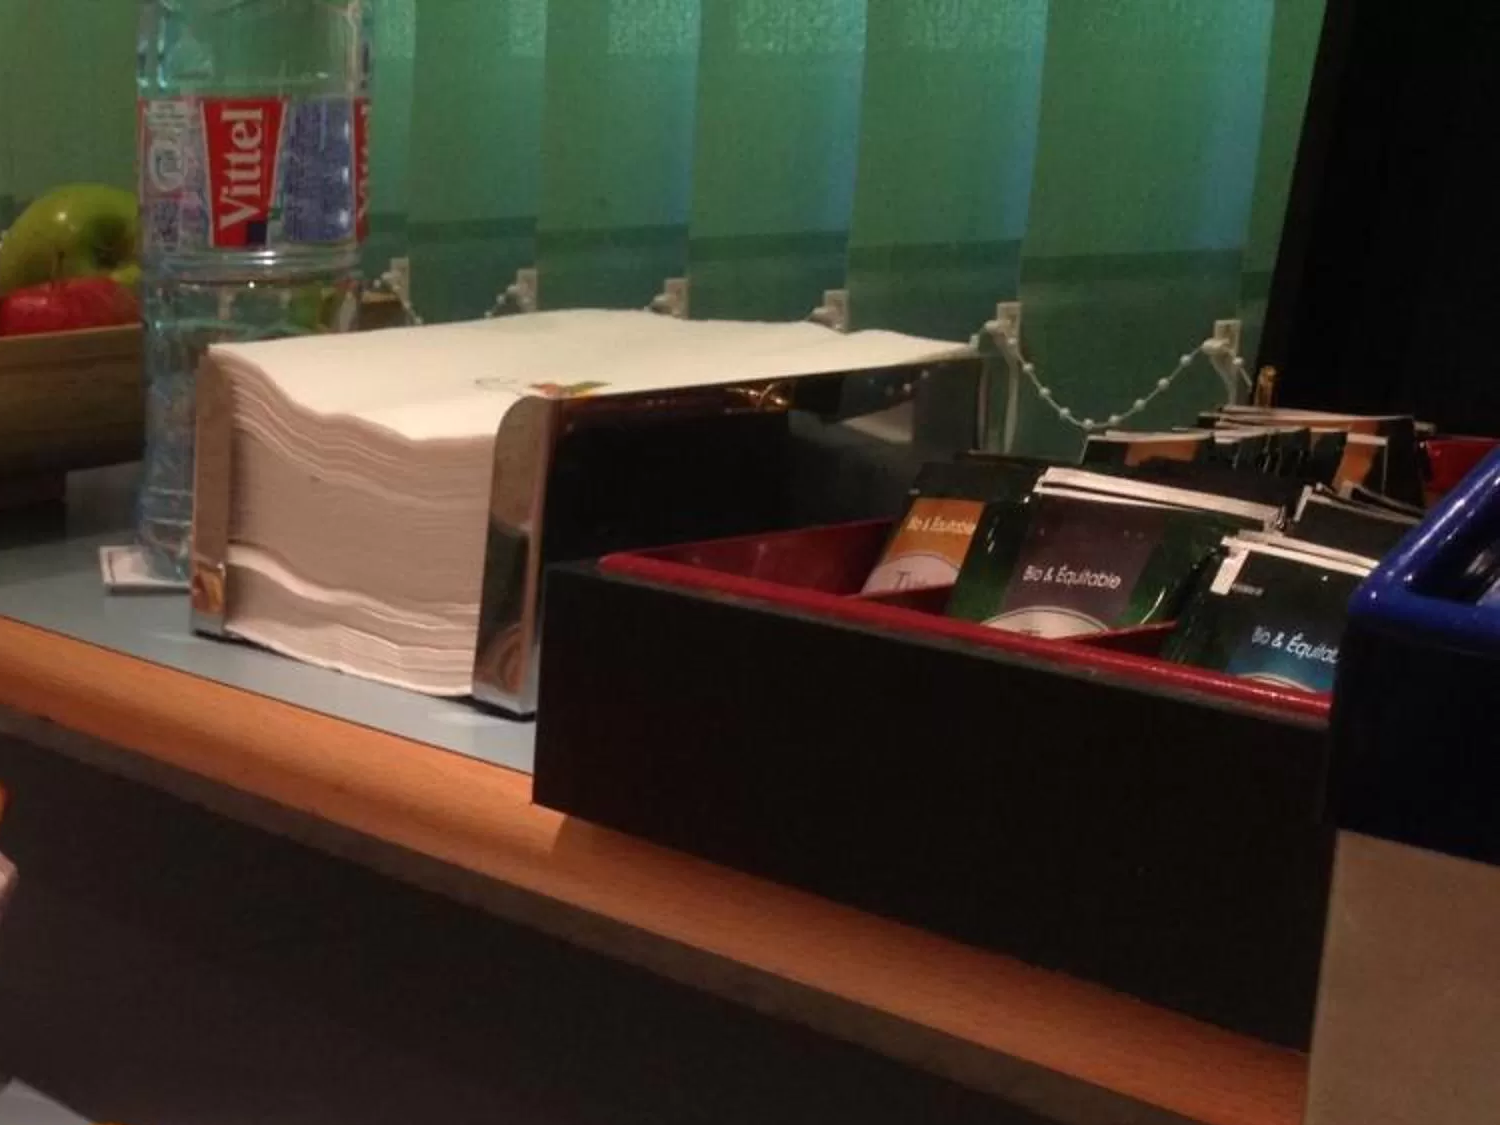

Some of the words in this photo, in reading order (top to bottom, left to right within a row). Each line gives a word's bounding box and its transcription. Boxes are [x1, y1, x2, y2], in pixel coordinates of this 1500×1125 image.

[218, 106, 263, 230] Vittel
[1022, 564, 1043, 582] Bio
[1043, 566, 1055, 582] &
[1055, 563, 1122, 590] Équitable
[1251, 625, 1271, 645] Bio
[1271, 632, 1285, 649] &
